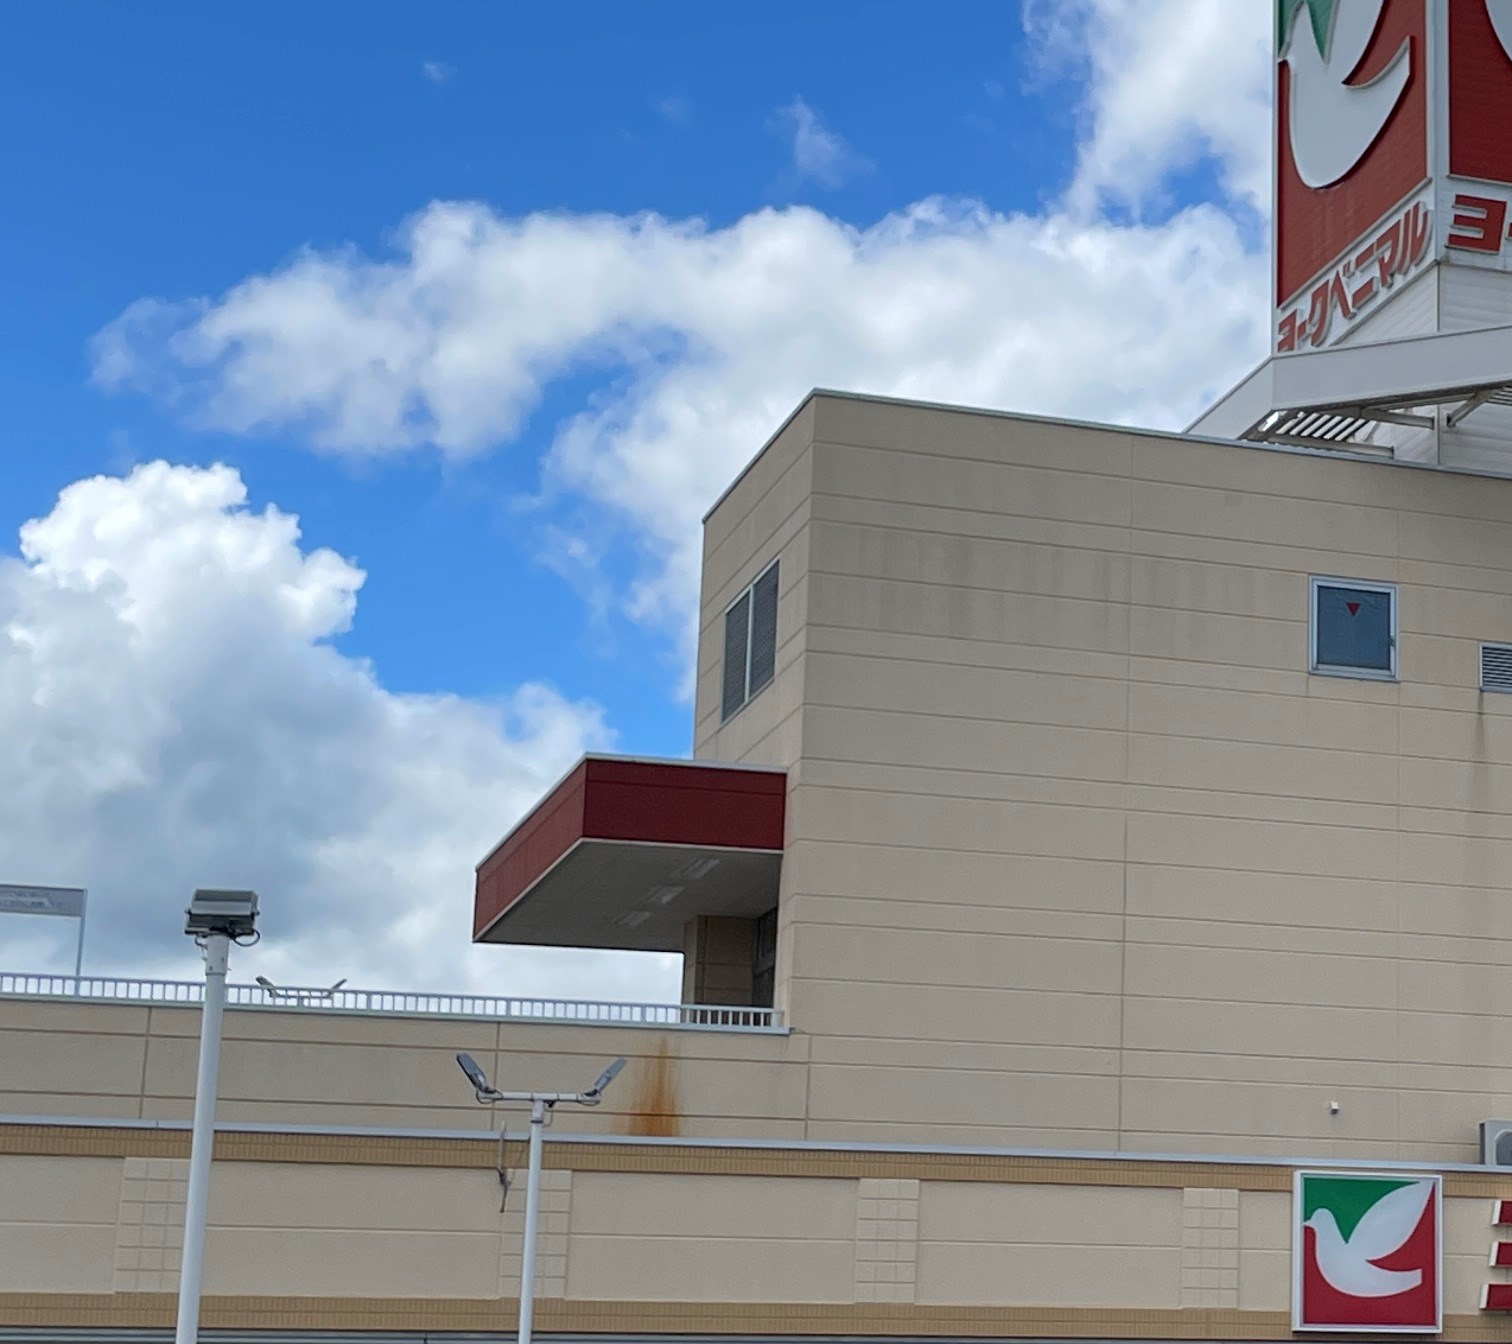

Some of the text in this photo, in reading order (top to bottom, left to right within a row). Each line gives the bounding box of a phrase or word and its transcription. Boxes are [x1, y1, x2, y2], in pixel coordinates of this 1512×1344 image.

[1277, 201, 1433, 354] ヨークベニマル
